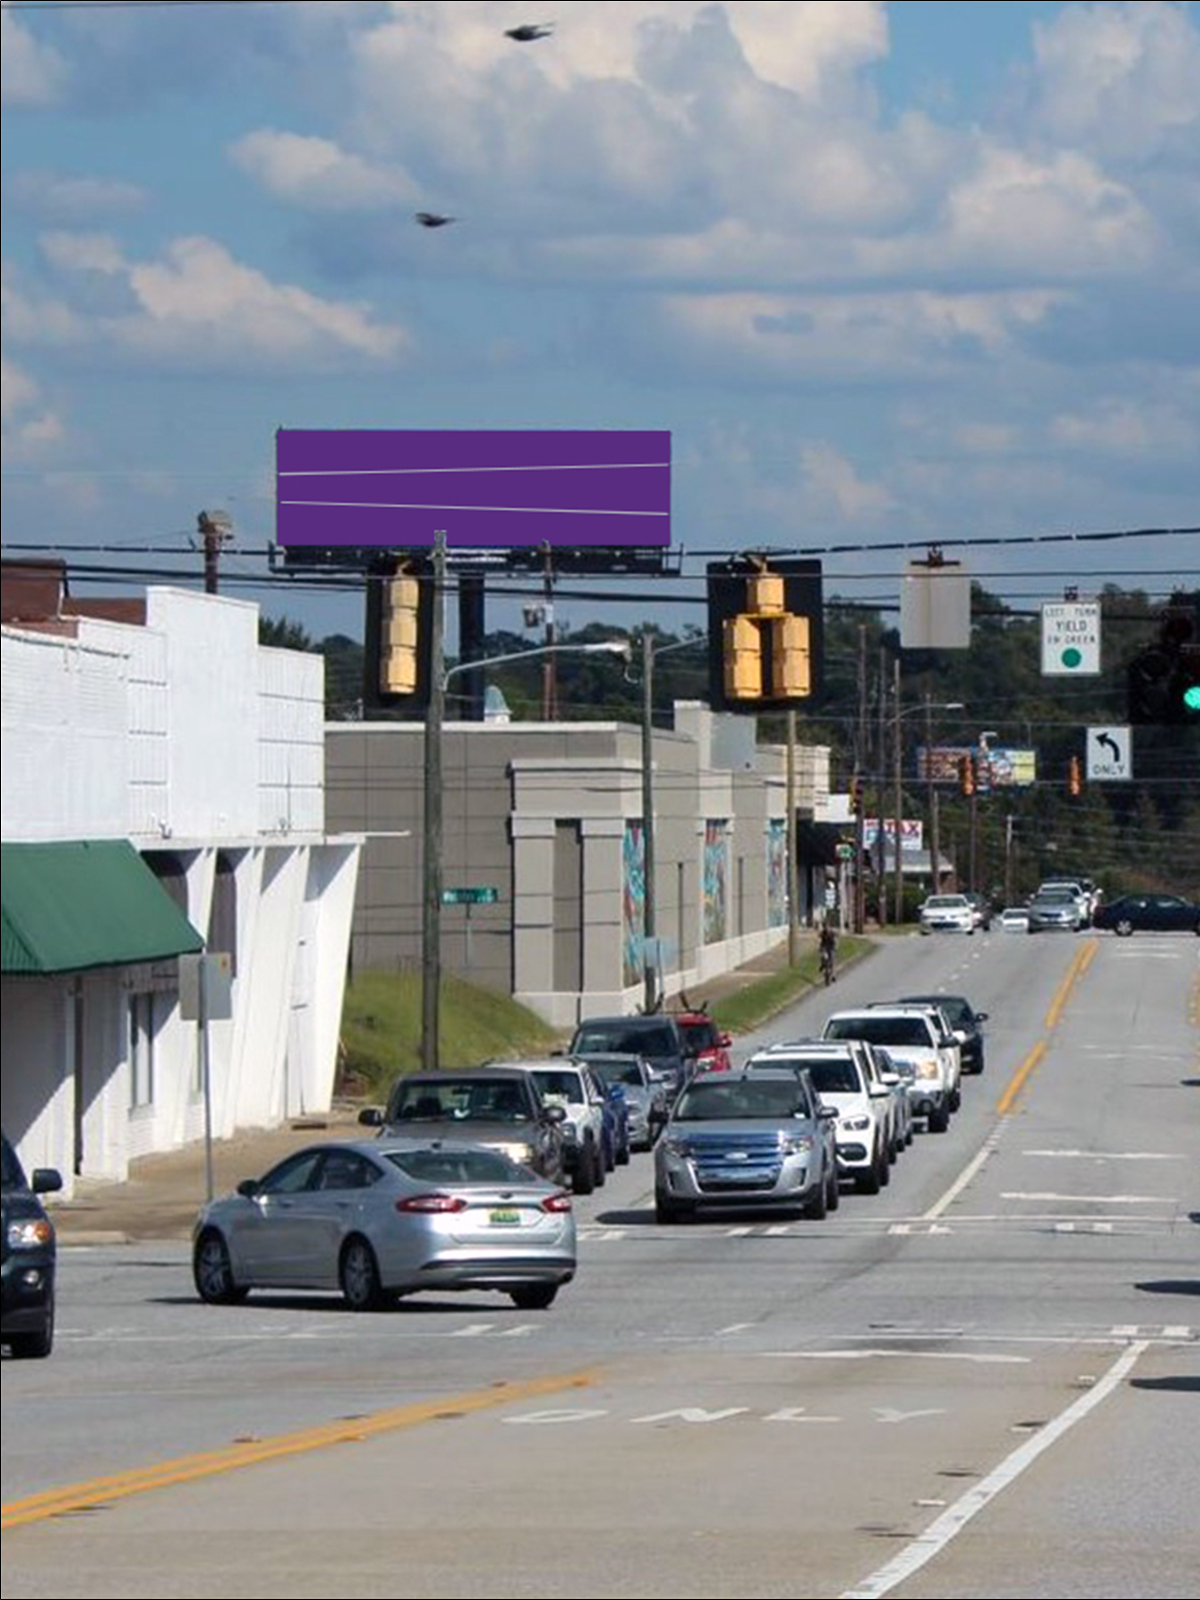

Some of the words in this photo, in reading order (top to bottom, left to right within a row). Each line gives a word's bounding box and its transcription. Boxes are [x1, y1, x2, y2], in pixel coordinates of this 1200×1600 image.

[1056, 620, 1087, 633] YIELD
[1092, 764, 1126, 776] ONLY
[501, 1407, 947, 1424] ONLY
